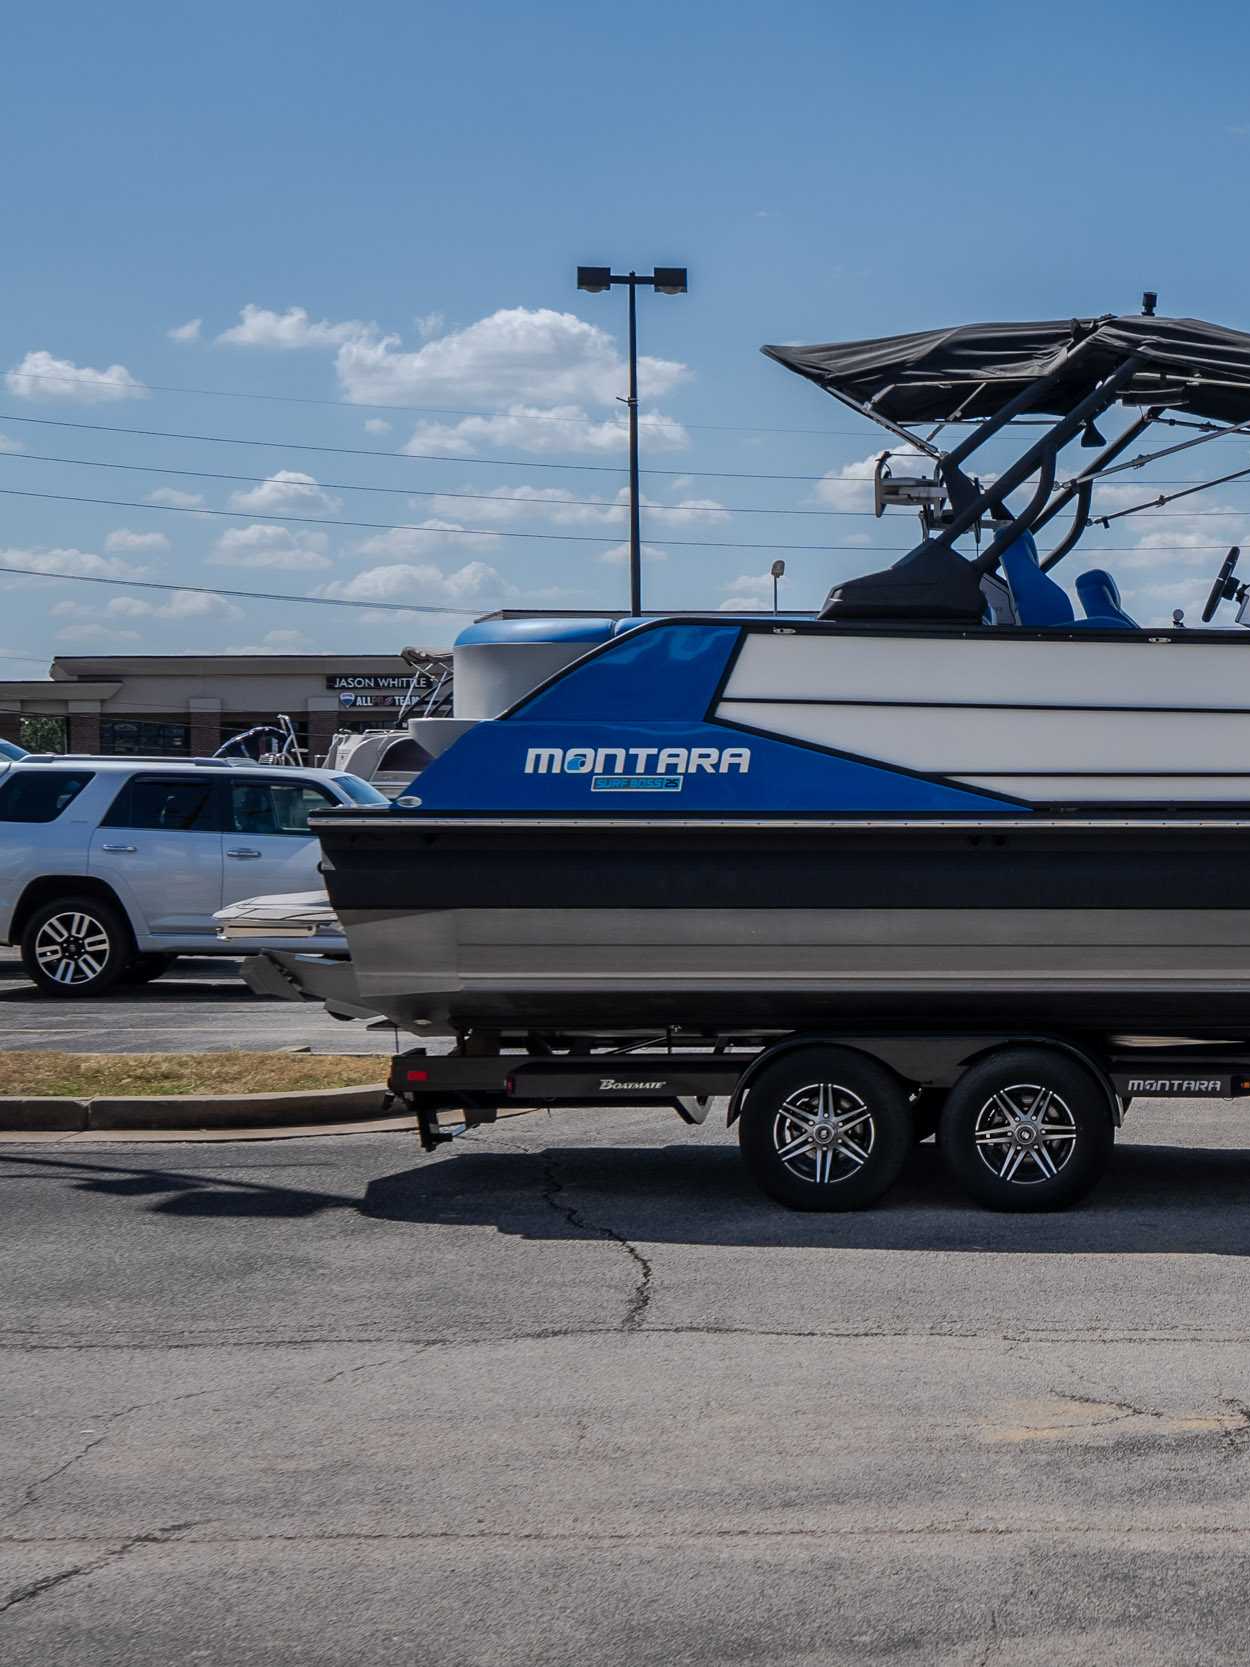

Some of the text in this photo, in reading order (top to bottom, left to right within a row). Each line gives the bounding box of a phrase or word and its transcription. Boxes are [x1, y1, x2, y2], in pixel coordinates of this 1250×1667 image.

[334, 677, 427, 688] JASON WHITTLE
[524, 748, 751, 774] MONTARA
[595, 778, 680, 789] SURF BOSS 25
[1127, 1080, 1221, 1091] MONTARA
